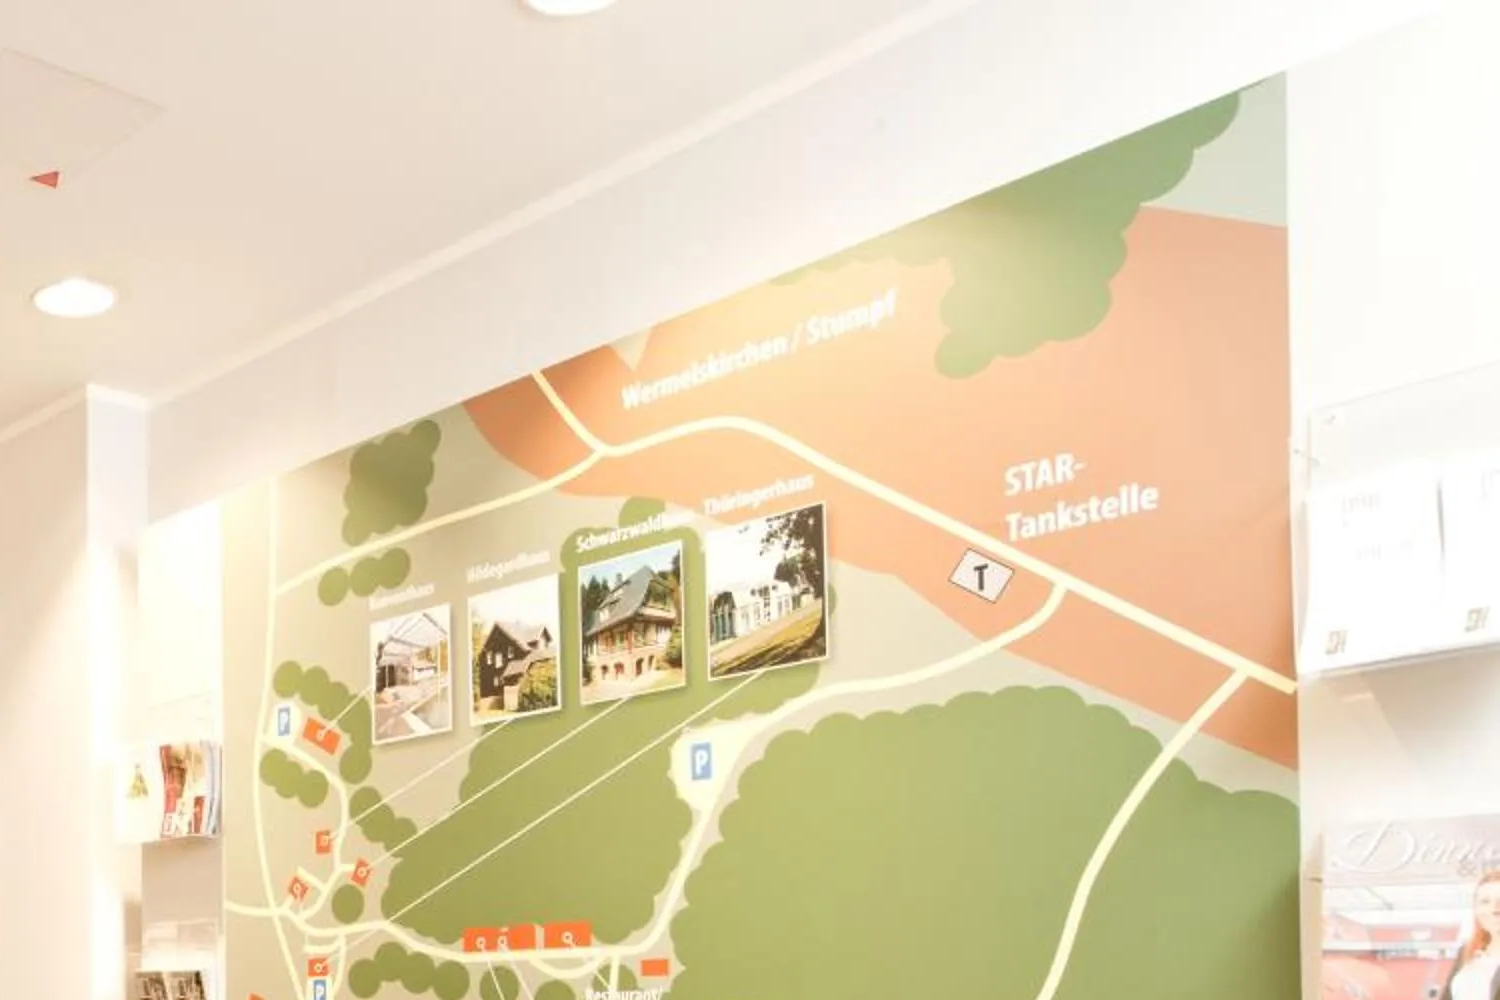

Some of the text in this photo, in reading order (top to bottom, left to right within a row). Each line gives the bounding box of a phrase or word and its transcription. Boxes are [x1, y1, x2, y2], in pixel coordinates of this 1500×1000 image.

[621, 332, 788, 410] Wermelskirchen
[807, 287, 899, 343] Stumpf
[1004, 452, 1085, 496] STAR-
[576, 510, 697, 553] Schwarzwald
[1005, 484, 1159, 542] Tankstelle
[973, 563, 989, 590] T
[695, 750, 708, 773] P
